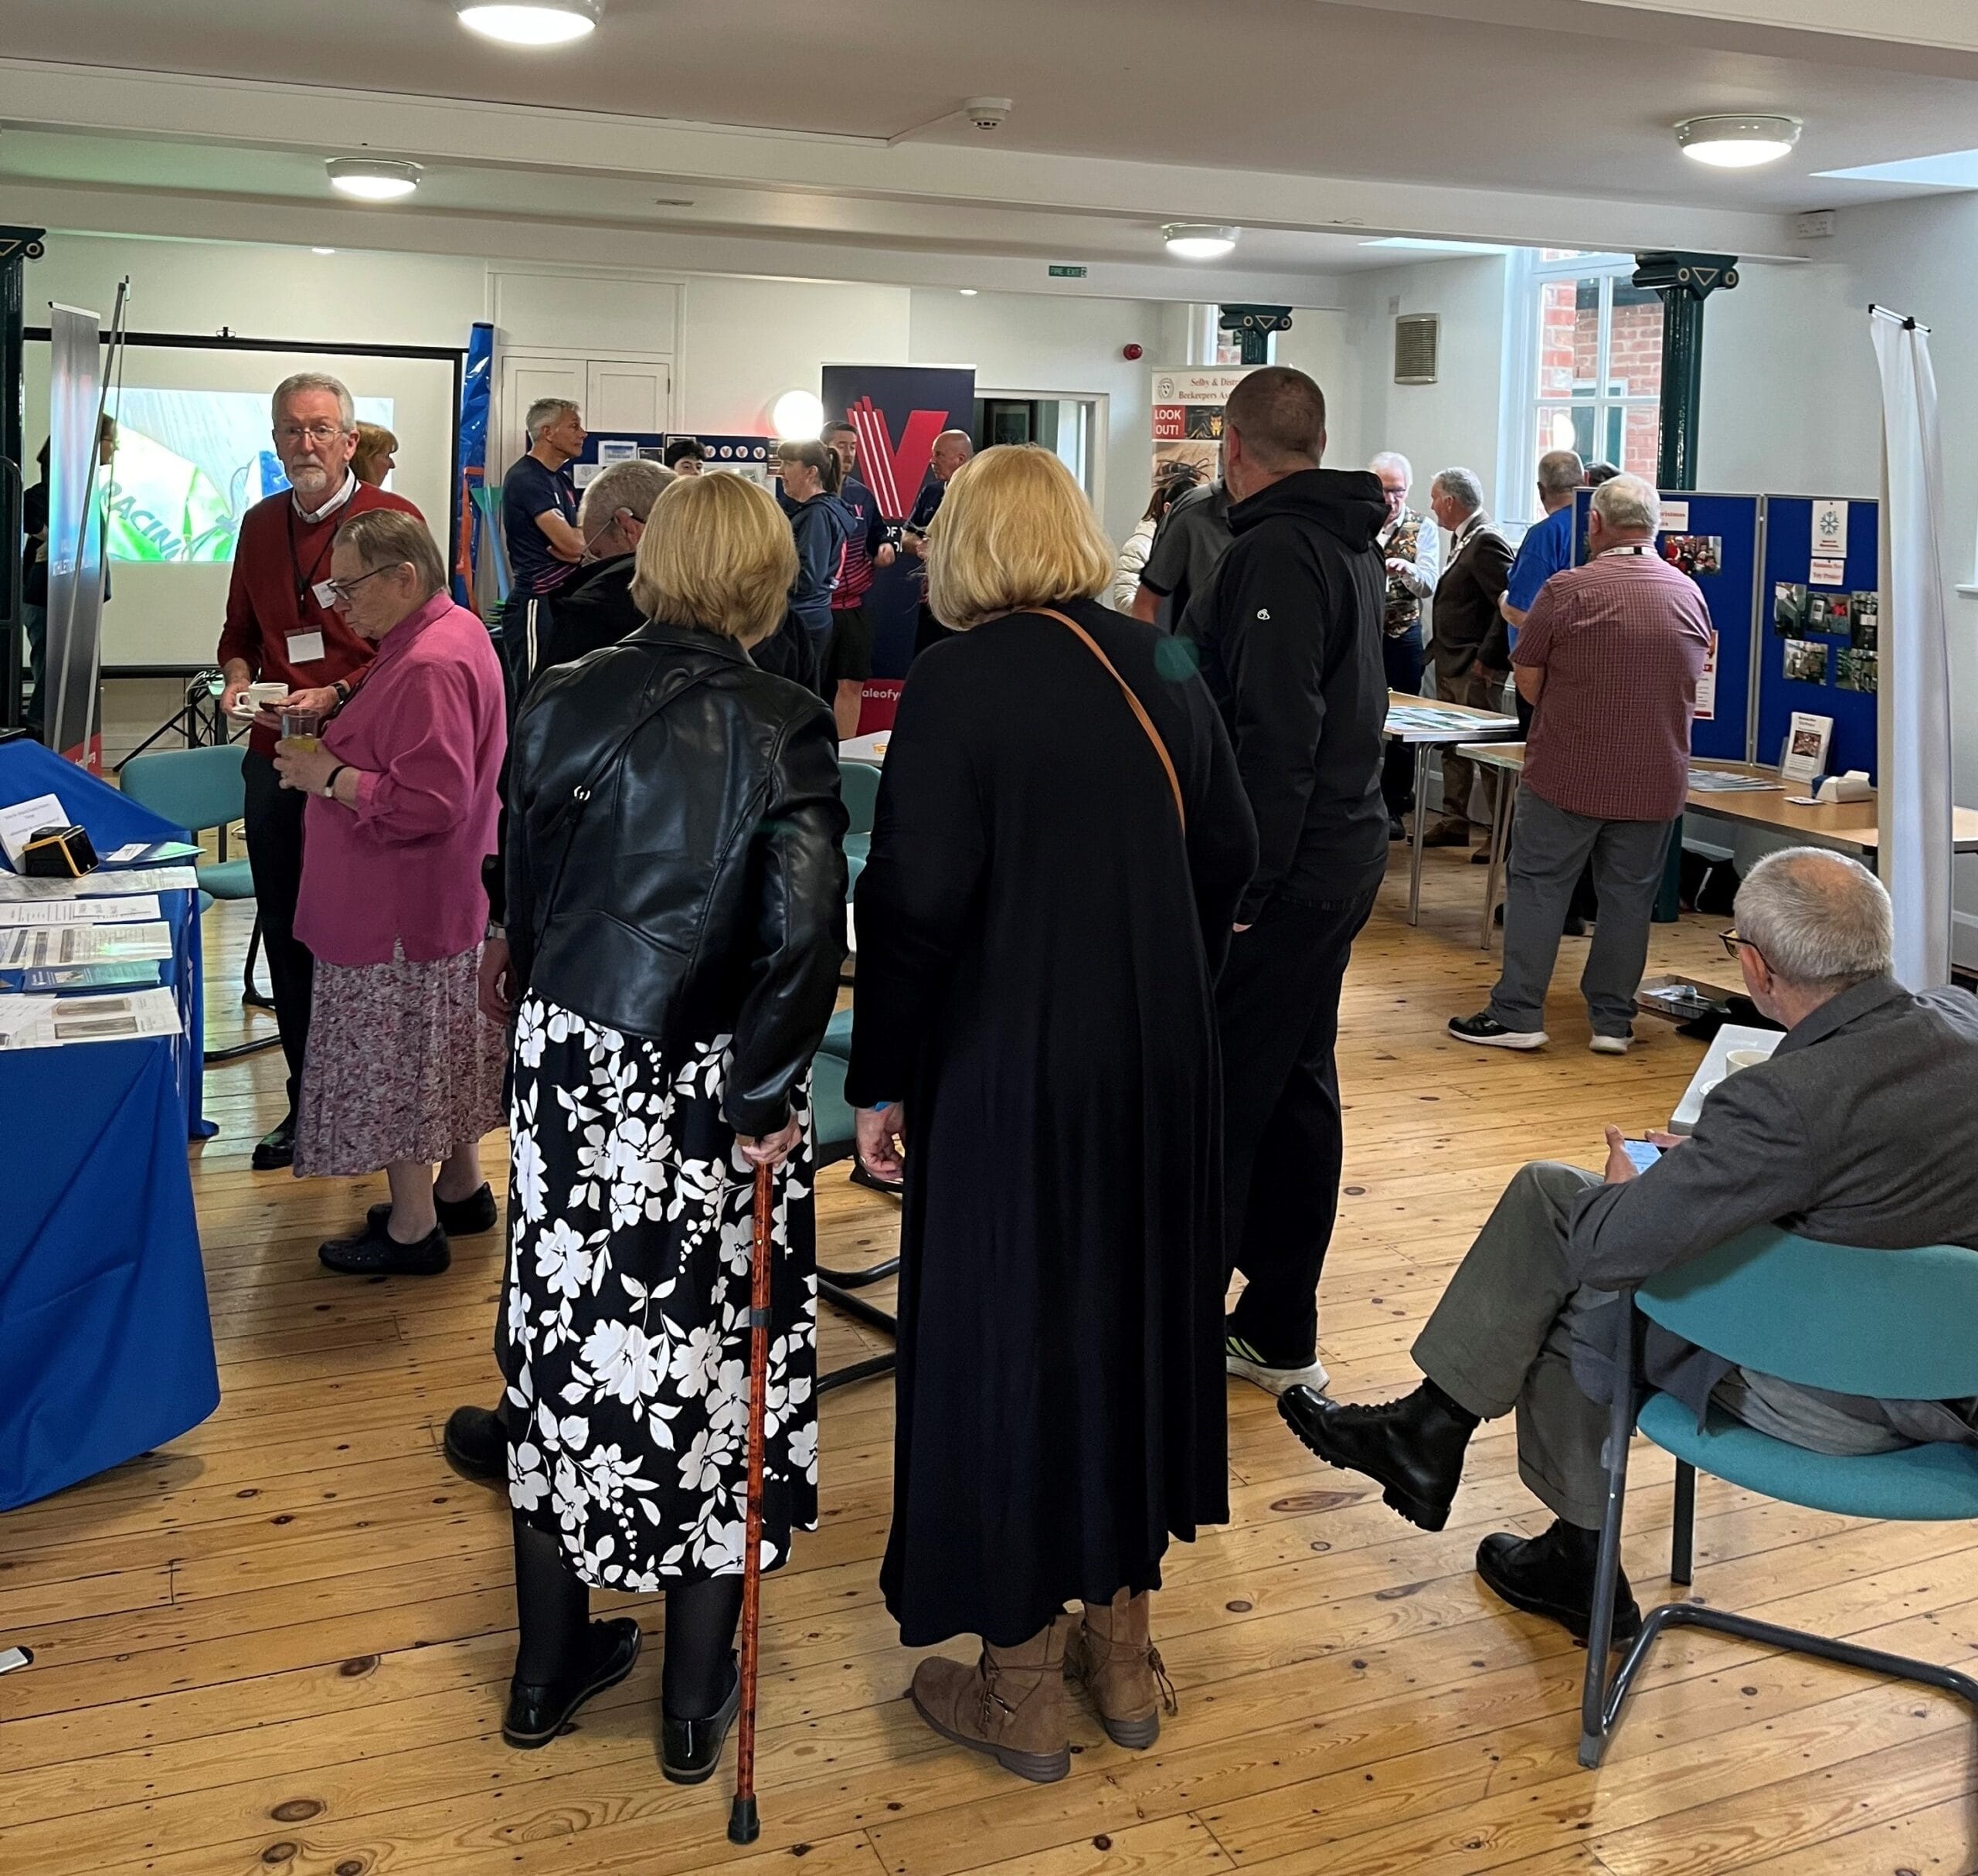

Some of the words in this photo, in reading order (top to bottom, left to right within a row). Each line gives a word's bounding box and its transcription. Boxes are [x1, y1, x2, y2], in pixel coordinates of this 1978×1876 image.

[1191, 378, 1209, 388] Selby
[1221, 378, 1239, 386] Distr
[1178, 391, 1218, 401] Beekeepers
[1154, 410, 1181, 420] LOOK
[1155, 425, 1179, 435] OUT!
[100, 481, 182, 559] RACIN
[862, 688, 902, 702] aleofy
